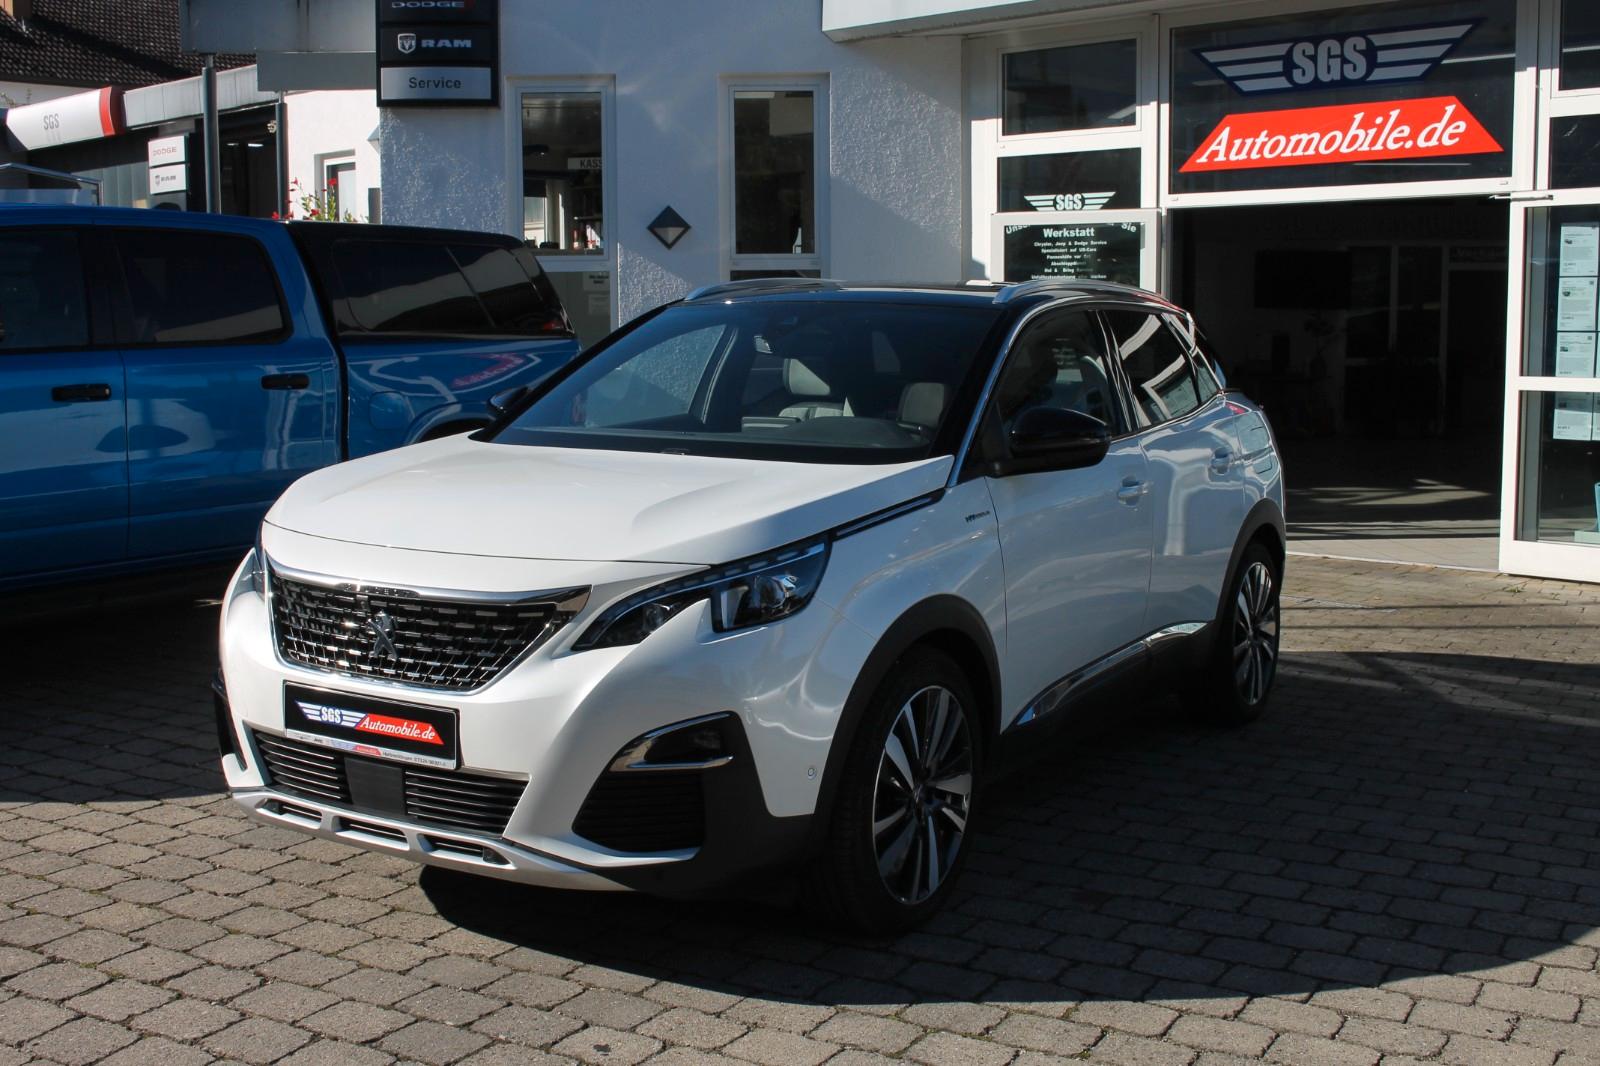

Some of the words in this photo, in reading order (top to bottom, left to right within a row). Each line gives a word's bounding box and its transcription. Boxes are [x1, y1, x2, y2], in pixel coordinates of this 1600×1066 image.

[421, 39, 472, 48] RAM
[1292, 36, 1367, 85] SGS
[408, 77, 462, 89] Service
[43, 113, 60, 131] SGS
[1196, 104, 1467, 164] Automobile.de
[1055, 193, 1083, 211] SGS
[1043, 227, 1095, 238] Werkstatt
[320, 706, 341, 724] SGS
[361, 717, 436, 740] Automobile.de
